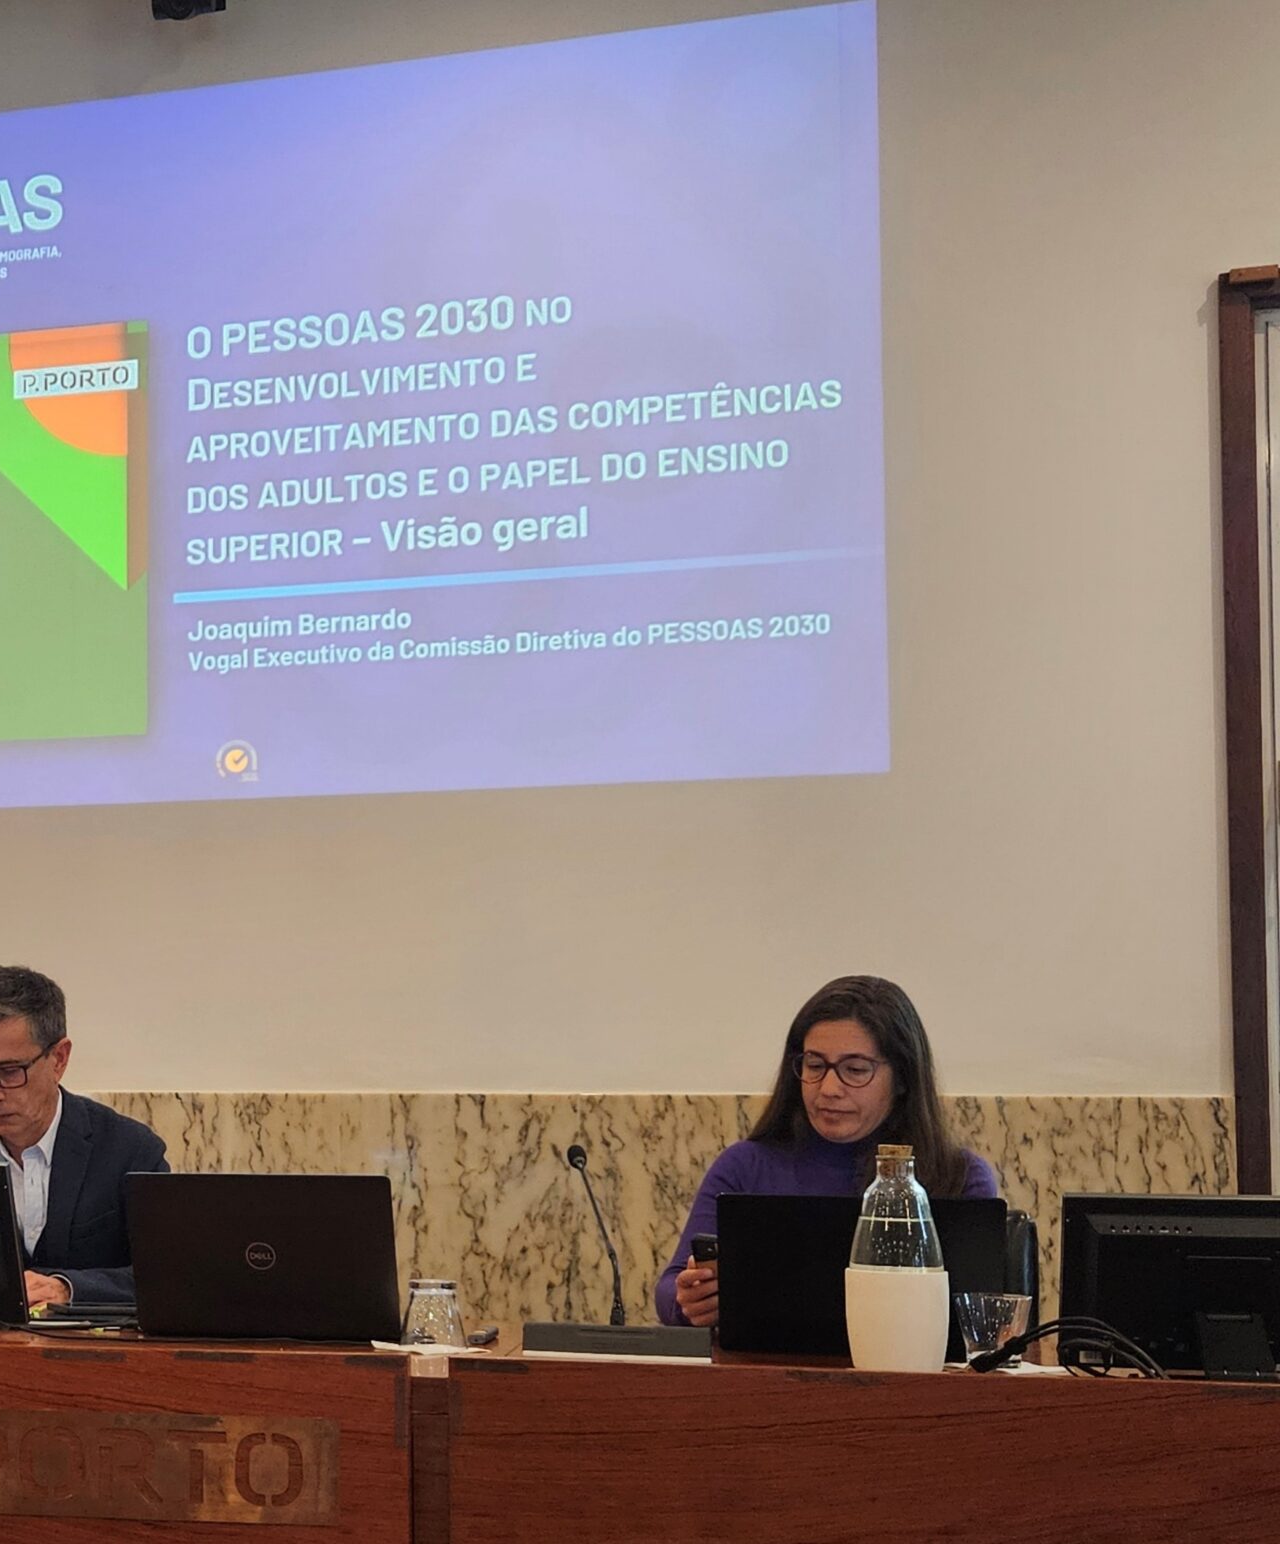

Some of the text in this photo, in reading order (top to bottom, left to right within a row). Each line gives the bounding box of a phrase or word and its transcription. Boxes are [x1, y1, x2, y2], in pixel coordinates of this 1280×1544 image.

[186, 294, 572, 360] O PESSOAS 2030 NO
[21, 365, 130, 394] P.PORTO
[518, 352, 536, 381] E
[186, 379, 842, 464] APROVEITAMENTO DAS COMPETÊNCIAS
[186, 438, 789, 514] DOS ADULTOS E O PAPEL DO ENSINO
[186, 527, 342, 565] SUPERIOR
[381, 517, 482, 554] Visão
[493, 506, 588, 553] geral
[188, 608, 412, 644] Joaquim Bernardo
[188, 612, 830, 674] Vogal Executivo da Comissão Diretiva do PESSOAS 2030
[250, 1252, 273, 1260] DELL
